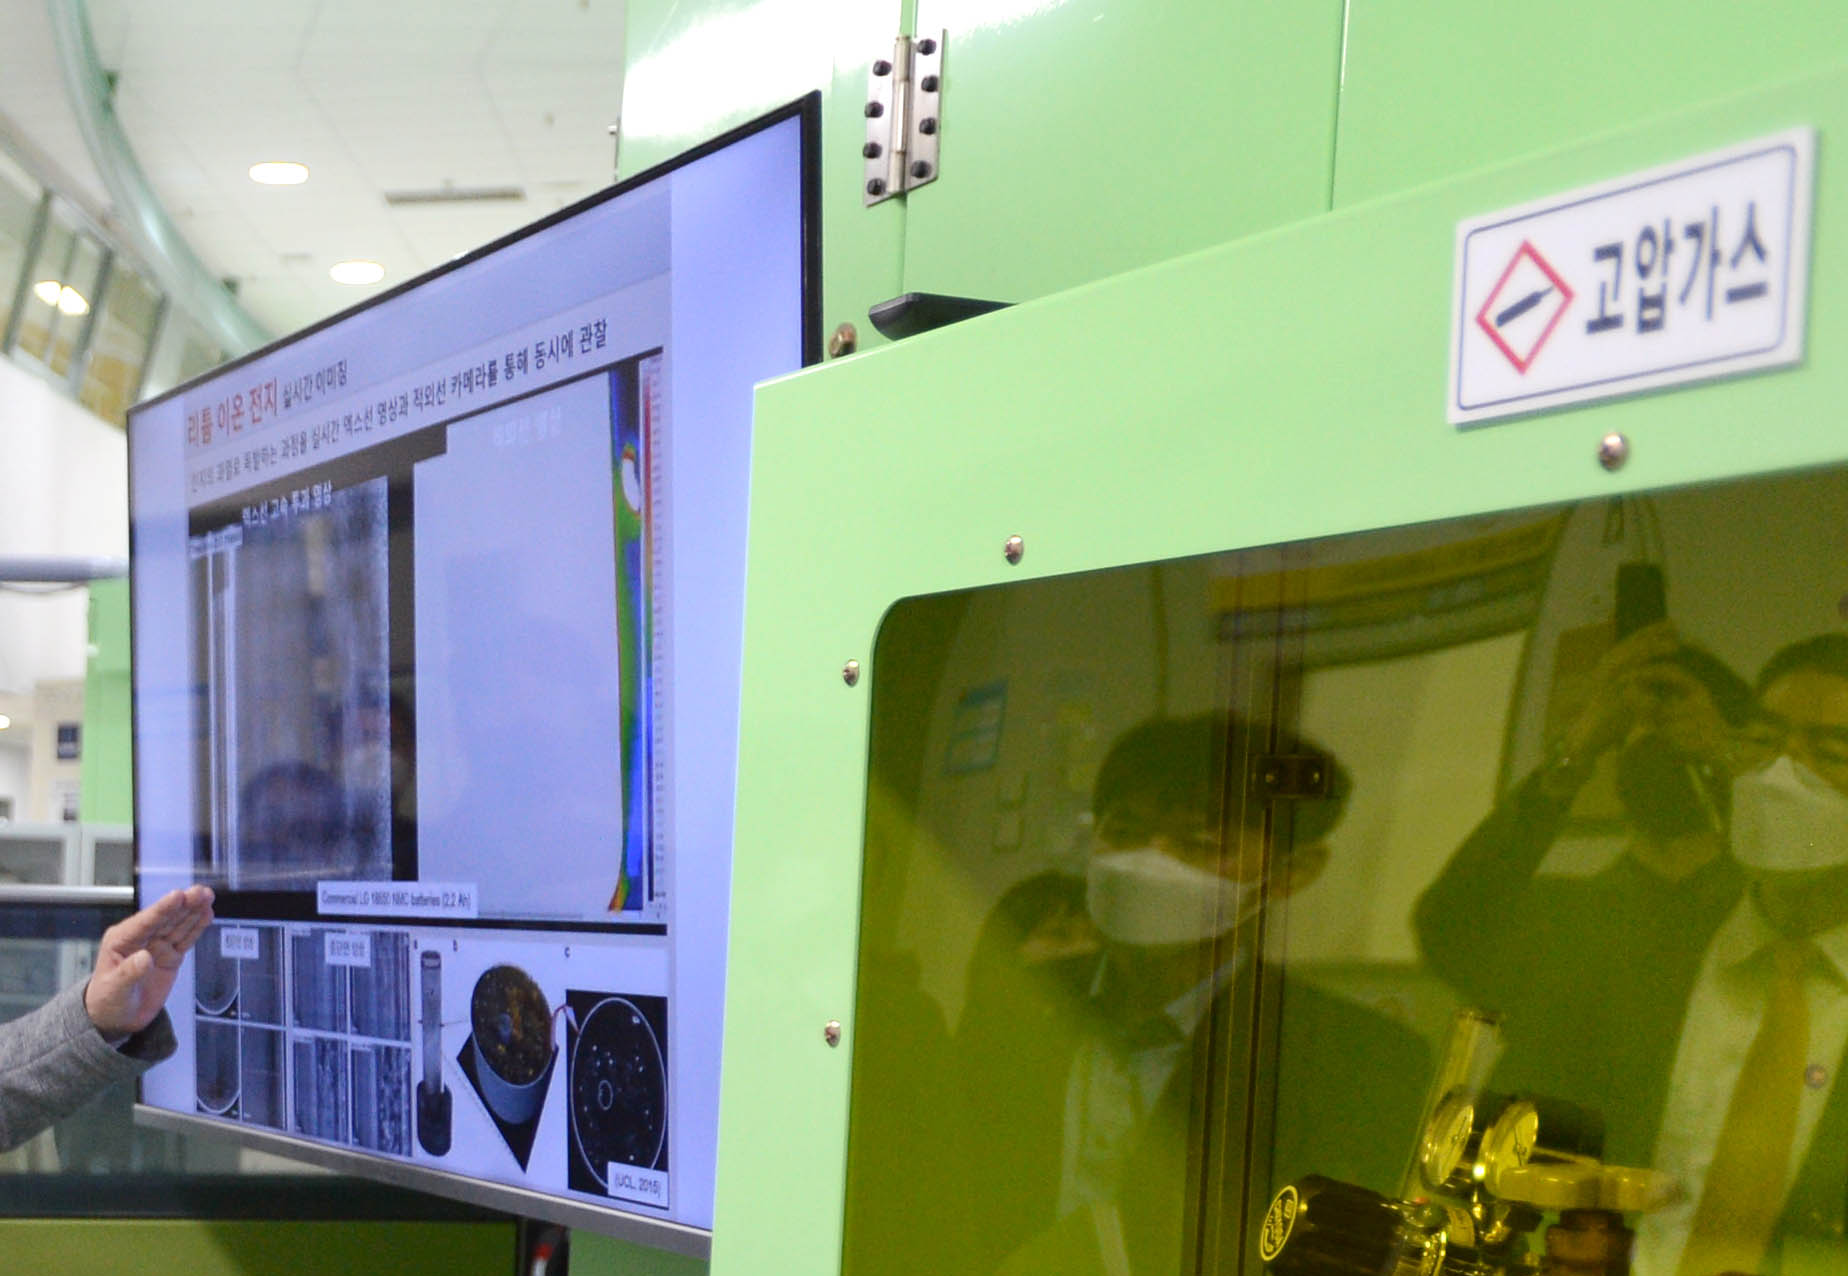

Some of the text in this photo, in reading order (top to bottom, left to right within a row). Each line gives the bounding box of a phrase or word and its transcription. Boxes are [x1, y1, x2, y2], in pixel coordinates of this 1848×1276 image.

[1585, 202, 1769, 335] 고압가스
[187, 407, 213, 447] 리튬
[218, 393, 245, 436] 이온
[249, 377, 278, 424] 전지
[283, 375, 313, 408] 실시간
[311, 421, 340, 450] 실시간
[344, 404, 374, 436] 엑스선
[377, 391, 409, 426] 영상과
[413, 378, 447, 414] 적외선
[451, 359, 499, 399] 카메라를
[504, 347, 529, 380] 통해
[534, 329, 574, 370] 동시에
[580, 318, 608, 355] 관찰
